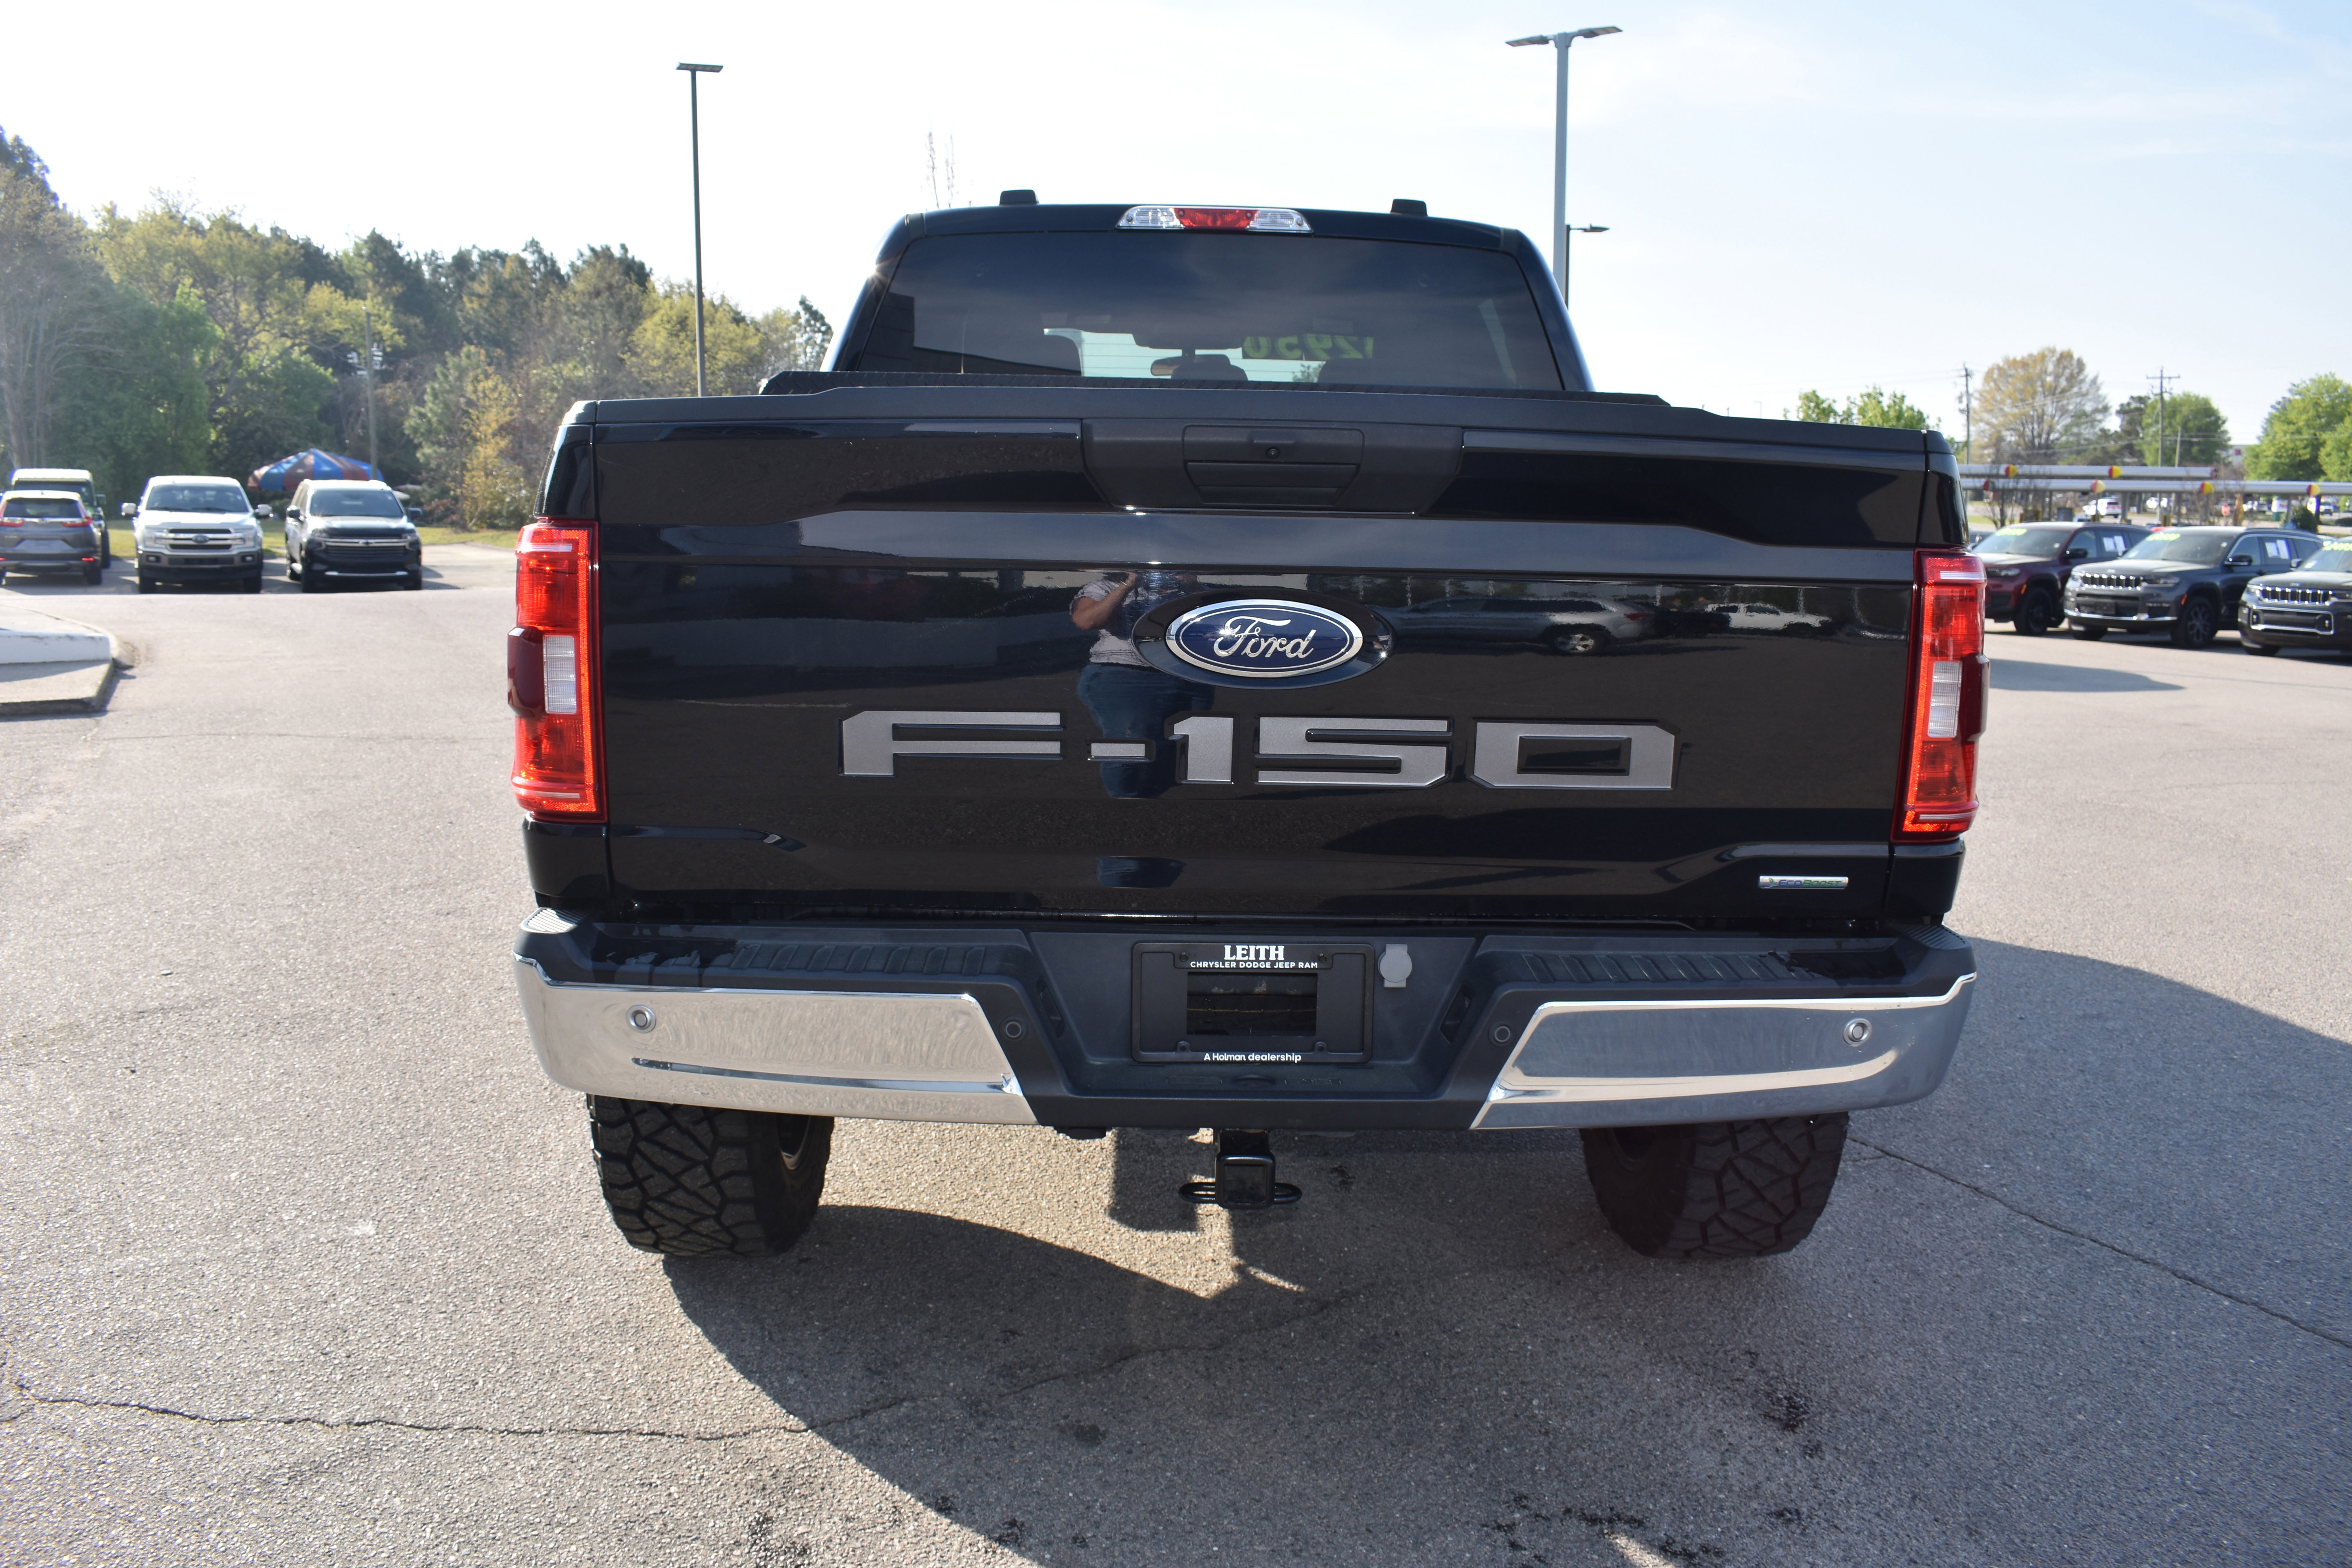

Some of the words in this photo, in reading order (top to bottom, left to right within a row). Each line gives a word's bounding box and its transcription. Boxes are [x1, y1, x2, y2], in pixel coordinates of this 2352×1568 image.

[1213, 616, 1316, 659] Ford
[841, 710, 1676, 789] F-150
[1224, 944, 1285, 960] LEITH
[1203, 1053, 1211, 1061] A
[1212, 1052, 1246, 1061] Holman
[1247, 1052, 1302, 1064] dealership
